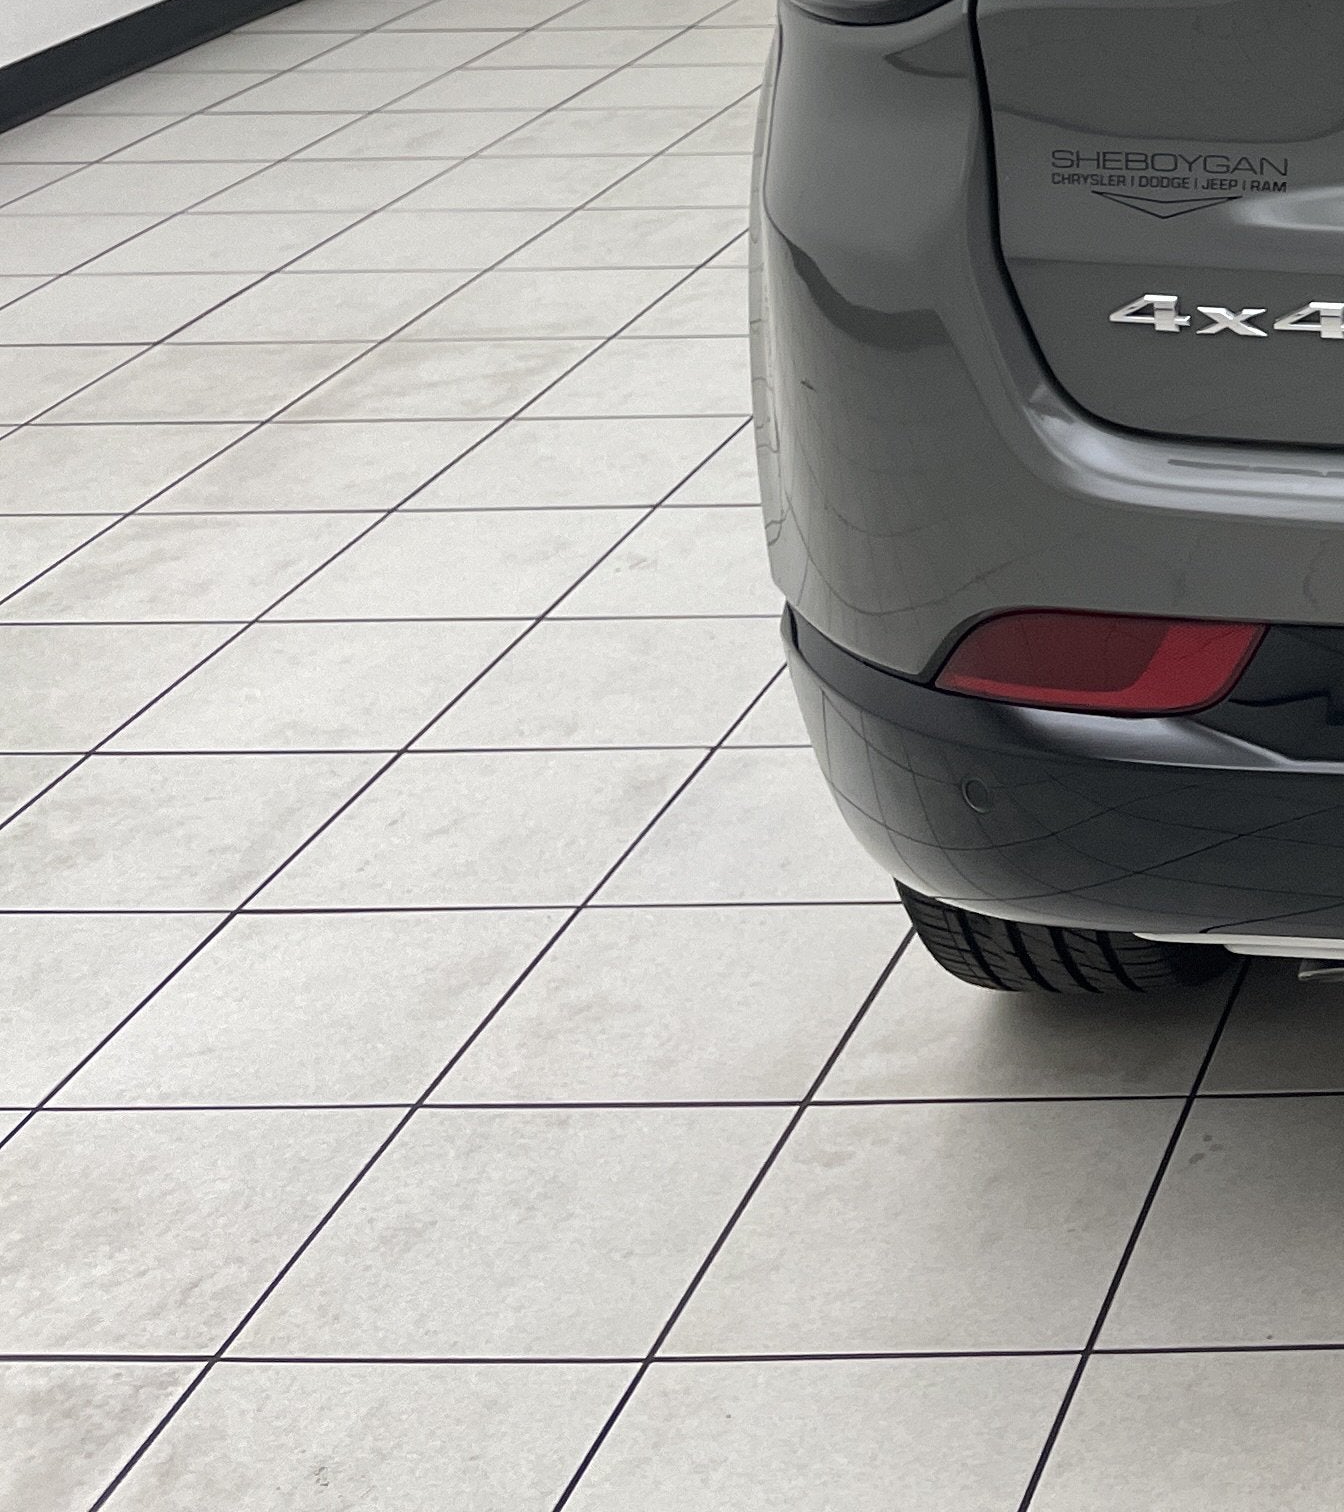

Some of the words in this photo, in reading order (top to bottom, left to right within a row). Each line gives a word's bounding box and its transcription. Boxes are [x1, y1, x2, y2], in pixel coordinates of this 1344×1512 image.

[1051, 149, 1289, 176] SHEBOYGAN
[1051, 172, 1126, 187] CHRYSLER
[1138, 176, 1190, 189] DODGE
[1202, 179, 1238, 190] JEEP
[1250, 180, 1287, 193] RAM
